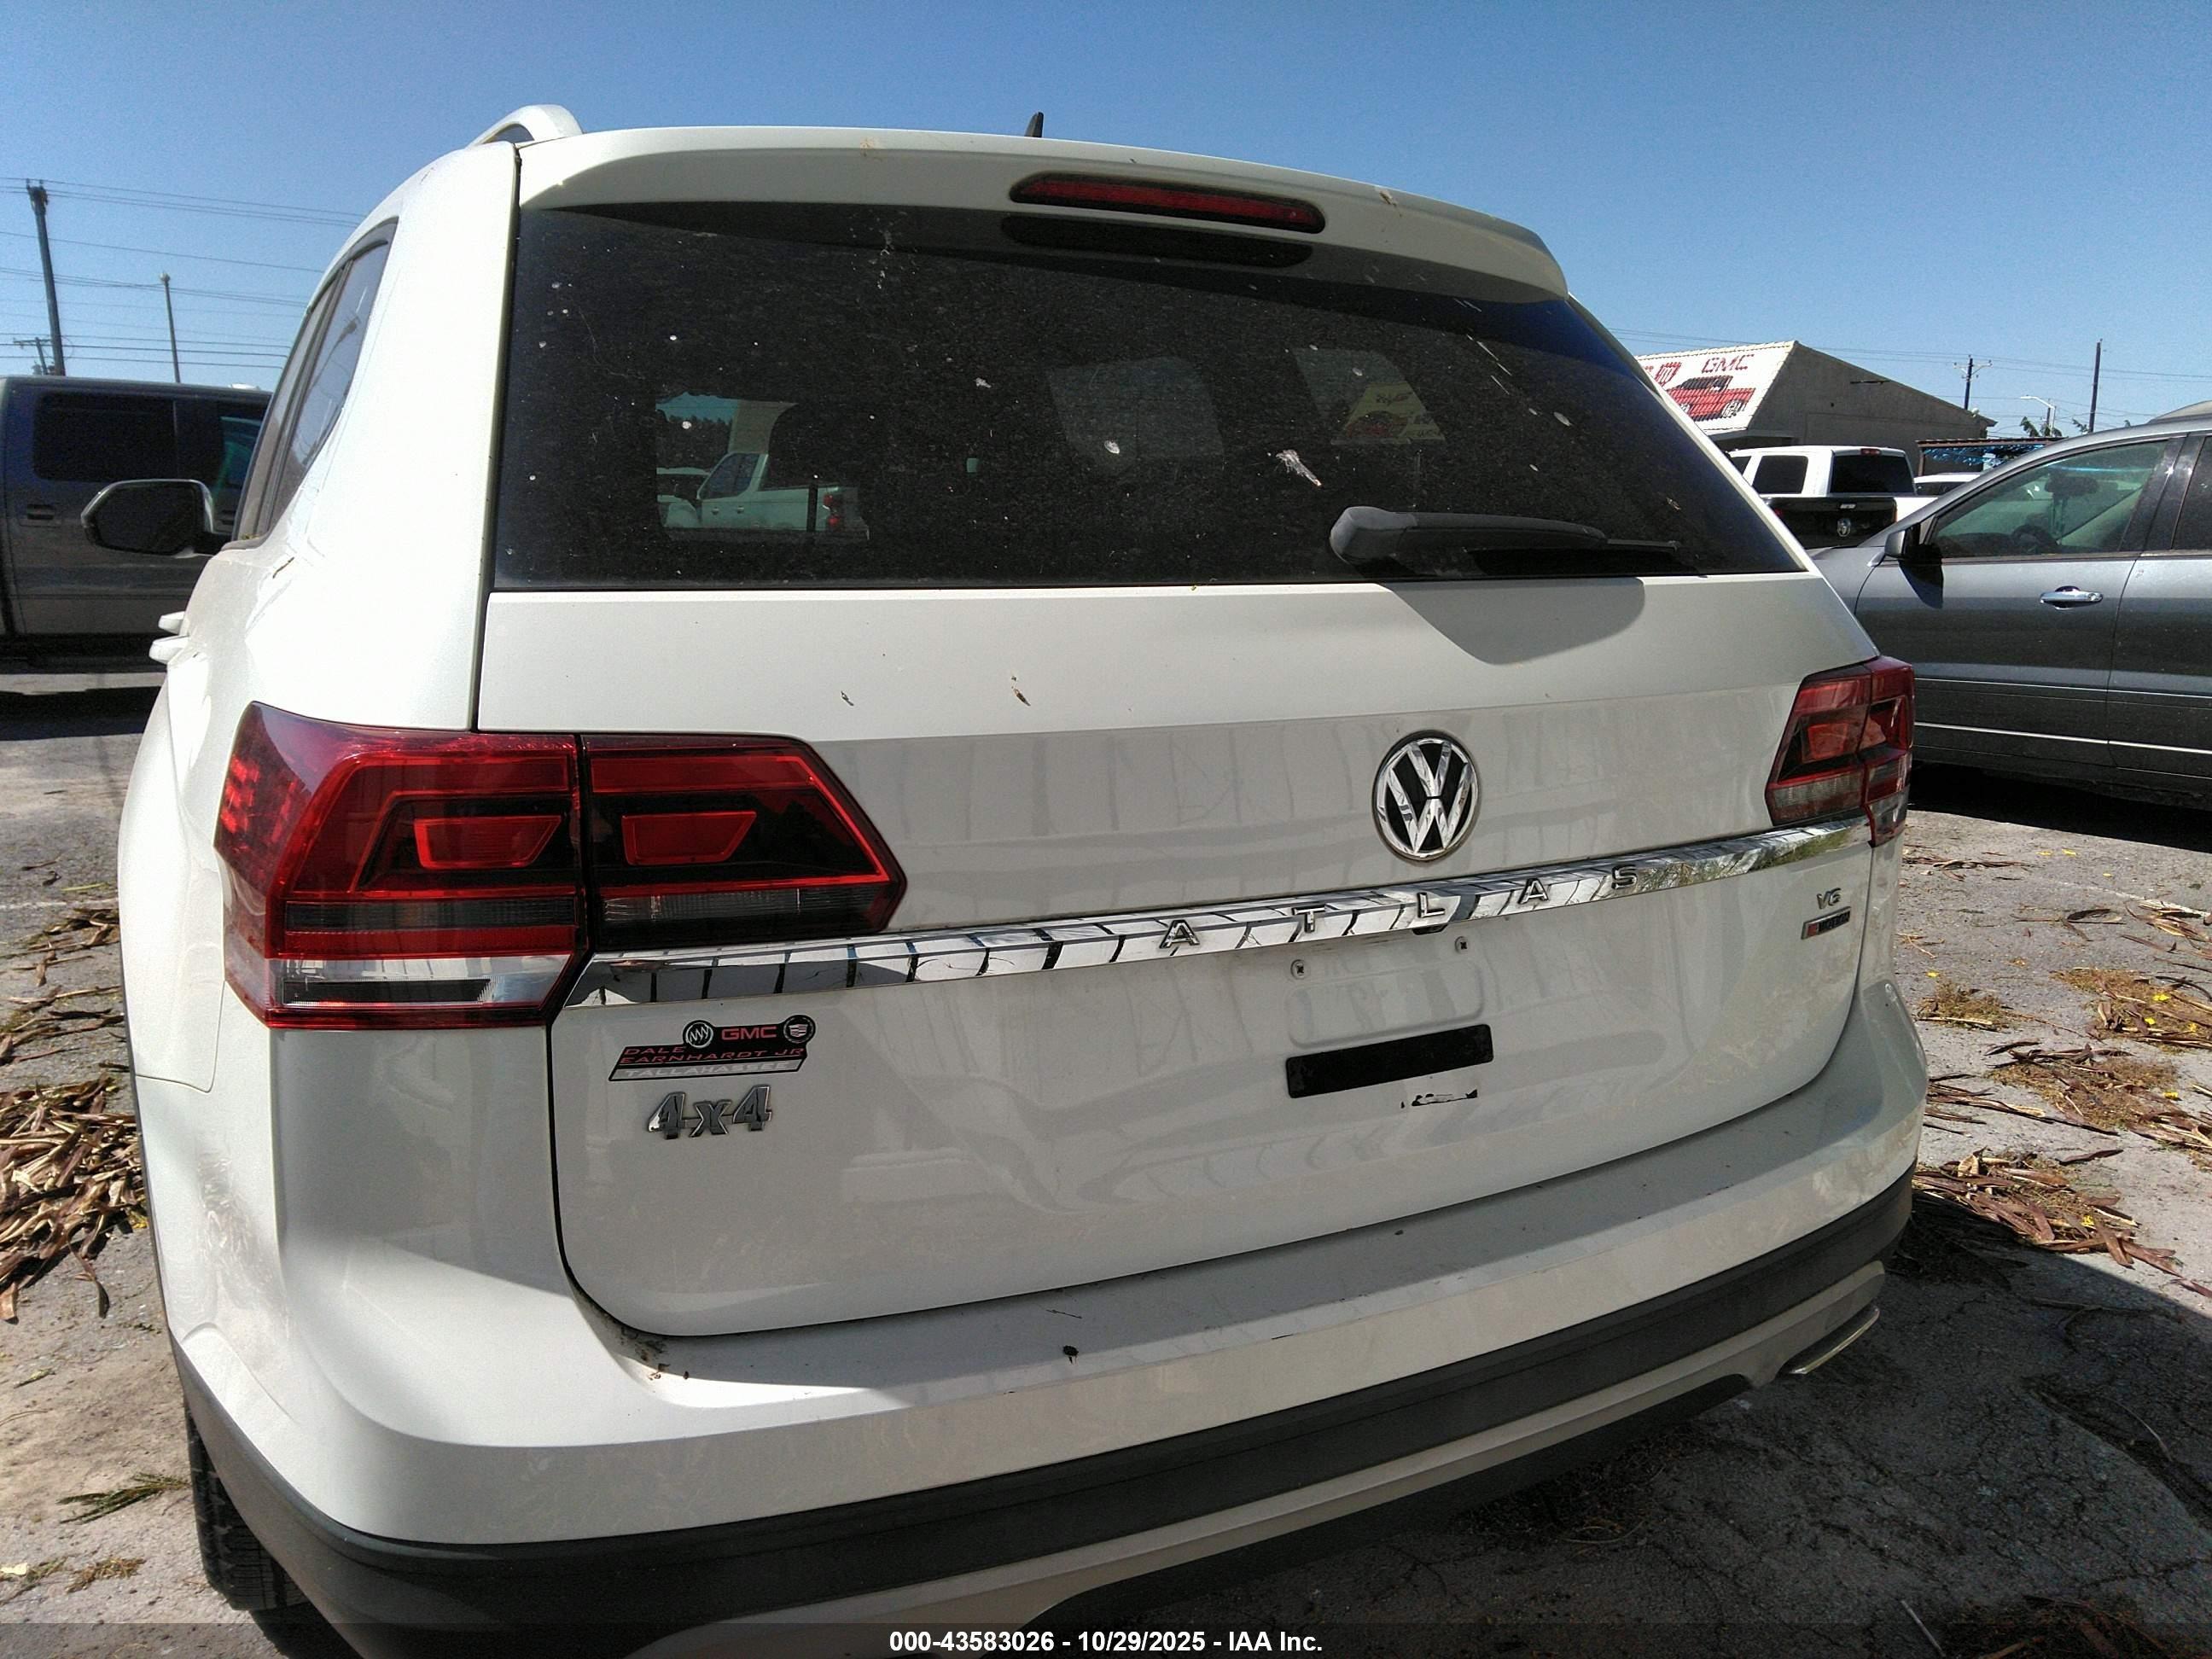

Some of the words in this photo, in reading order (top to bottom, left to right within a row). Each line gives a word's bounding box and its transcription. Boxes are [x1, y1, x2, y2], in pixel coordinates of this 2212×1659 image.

[1701, 353, 1755, 374] GMC
[1159, 864, 1639, 950] ATLAS
[1816, 887, 1842, 910] V6
[720, 1026, 777, 1040] GMC
[620, 1051, 767, 1065] EARNHARDT
[774, 1047, 805, 1057] JR
[624, 1046, 686, 1056] DALE
[647, 1084, 772, 1140] 4x4
